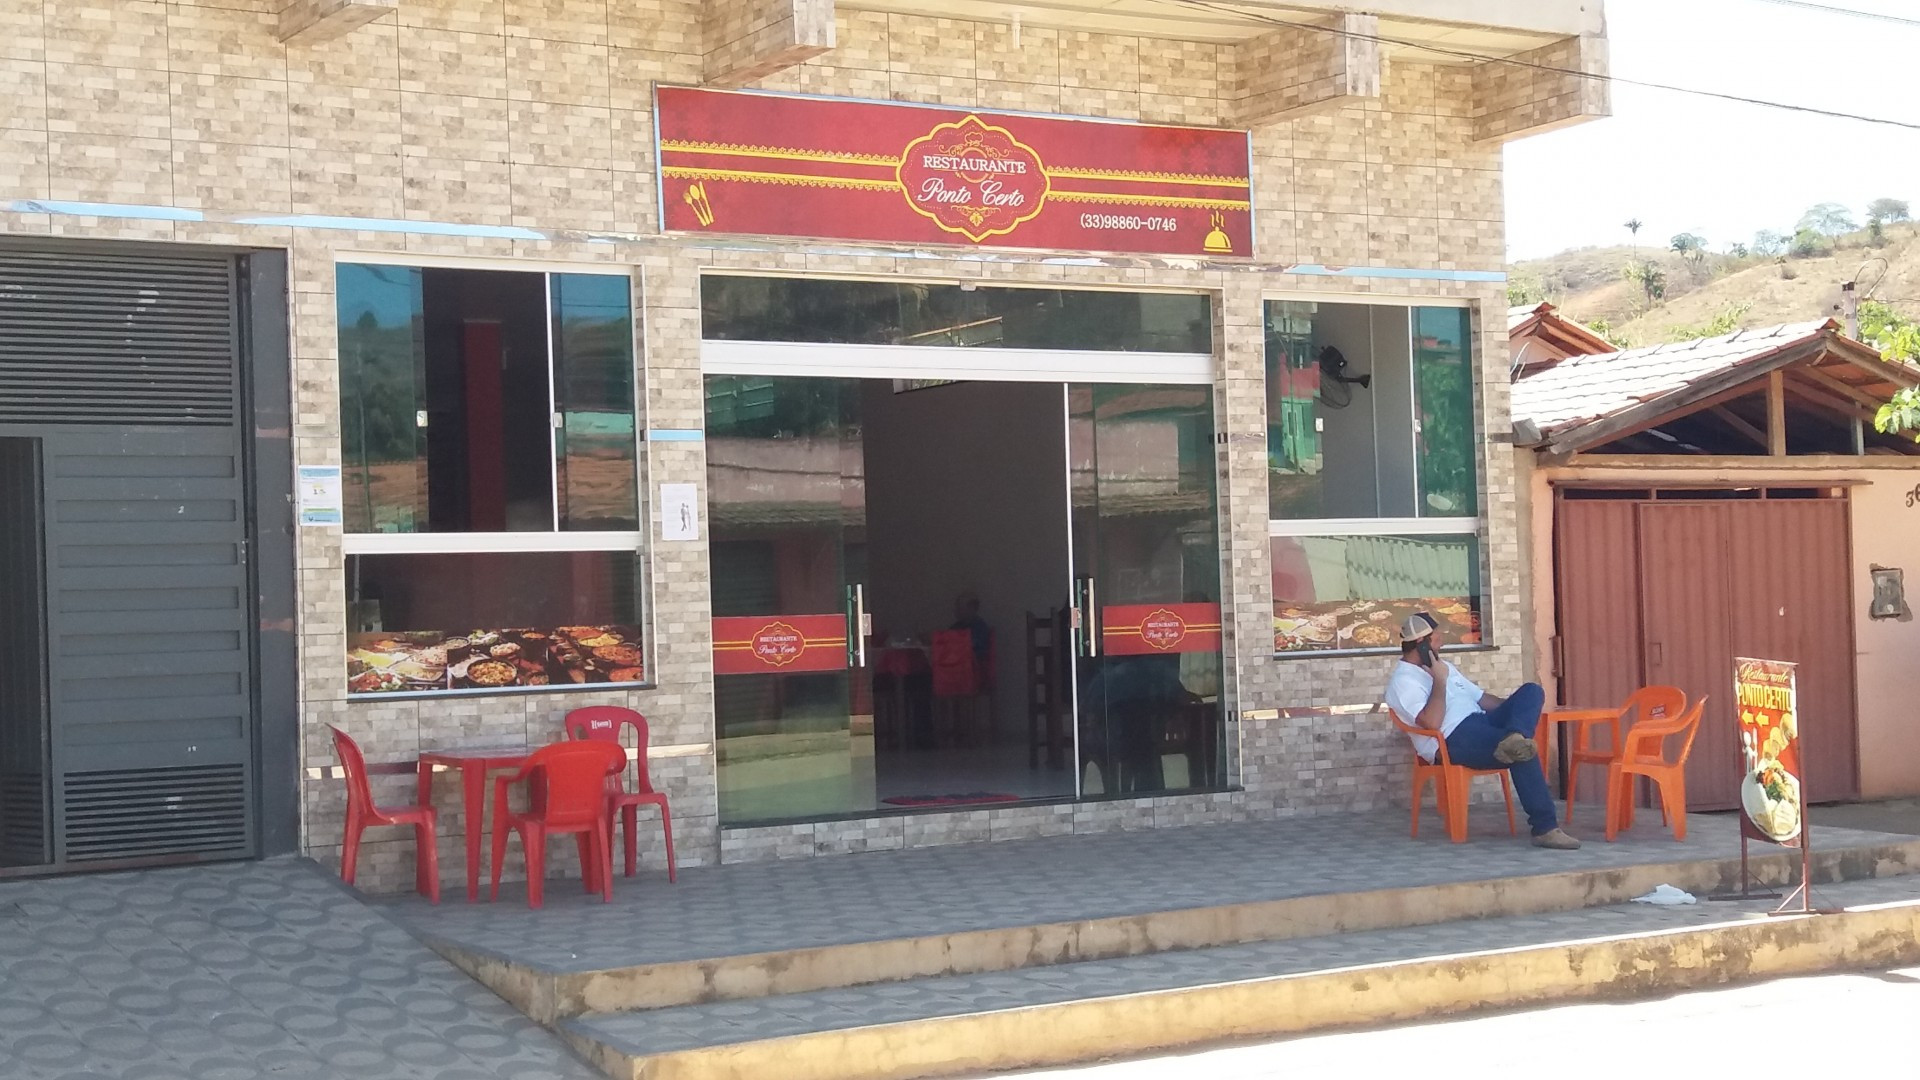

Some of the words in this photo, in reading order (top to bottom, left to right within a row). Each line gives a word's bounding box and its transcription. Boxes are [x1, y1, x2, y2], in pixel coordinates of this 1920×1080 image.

[923, 155, 1027, 174] RESTAURANTE
[917, 177, 972, 204] Ponto
[979, 180, 1025, 207] Certo
[1080, 213, 1177, 232] (33)98860-0746
[1738, 682, 1764, 708] PONTO
[1764, 685, 1793, 712] CERTO
